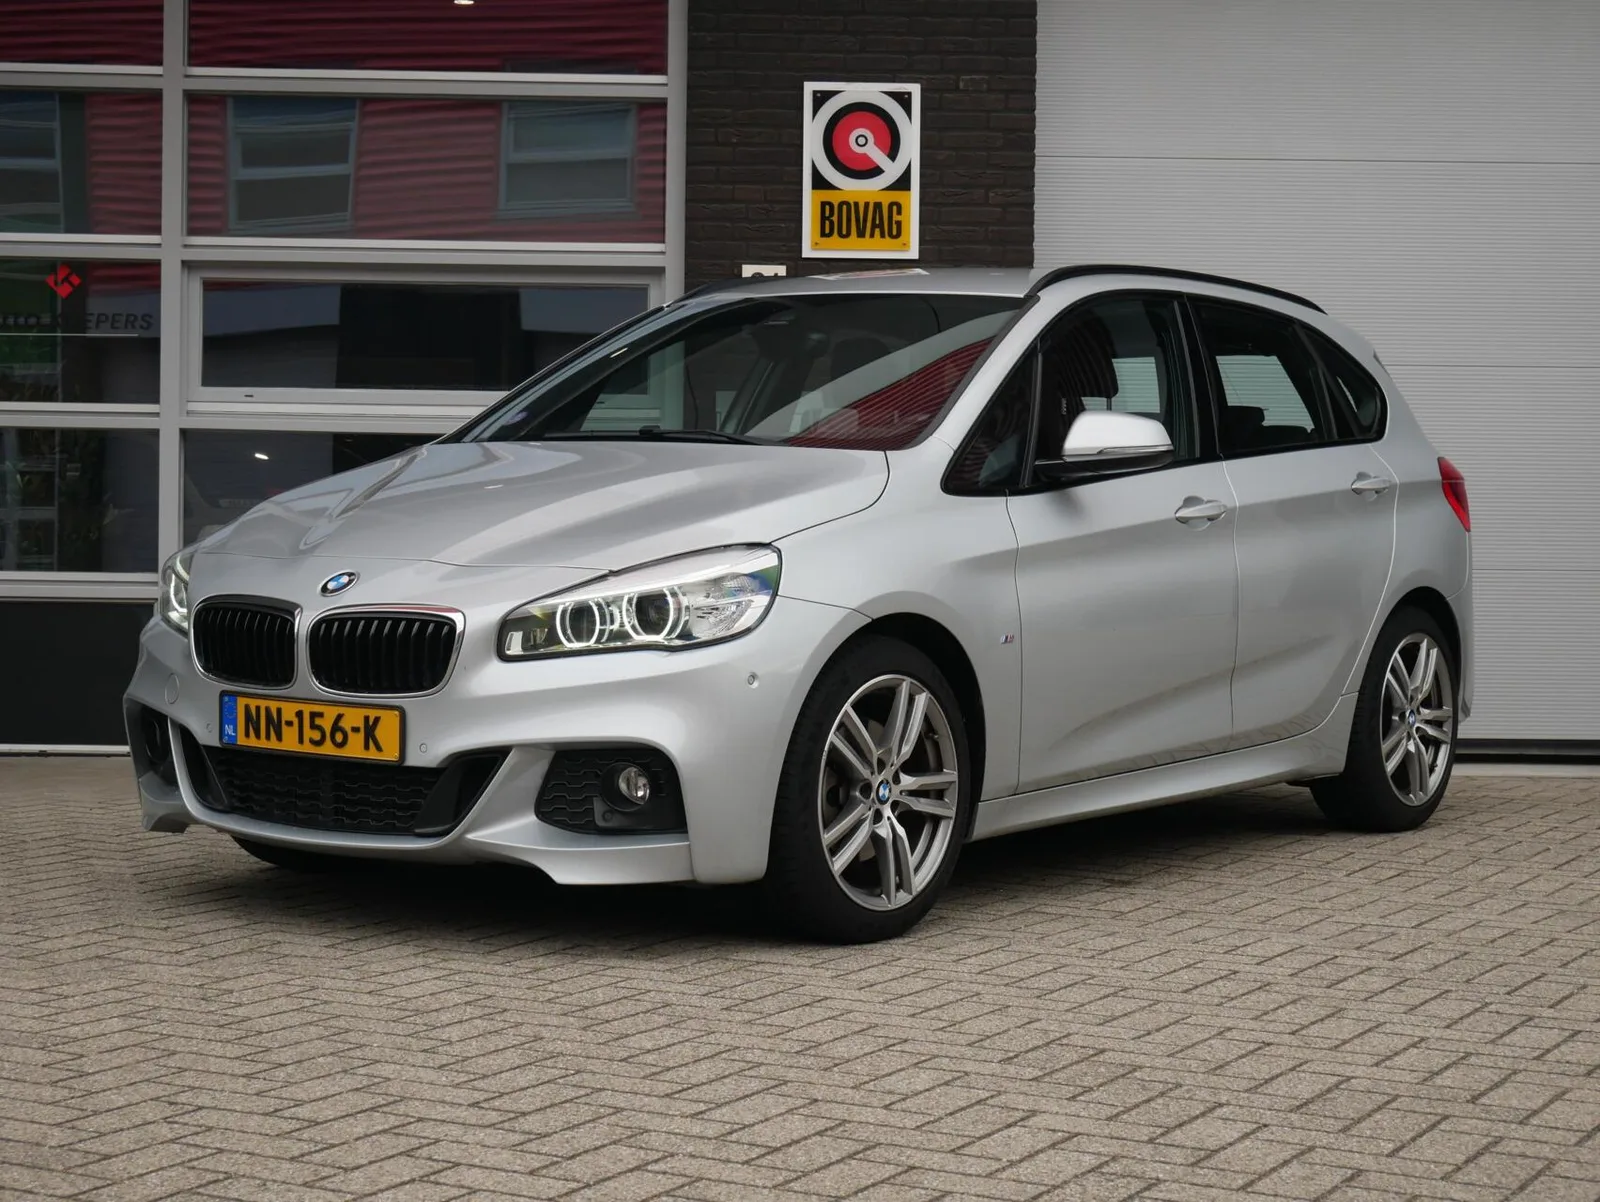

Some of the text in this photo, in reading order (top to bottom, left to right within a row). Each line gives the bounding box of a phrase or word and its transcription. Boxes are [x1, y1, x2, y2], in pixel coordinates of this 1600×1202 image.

[820, 200, 903, 239] BOVAG
[224, 703, 384, 753] NL NN-156-K
